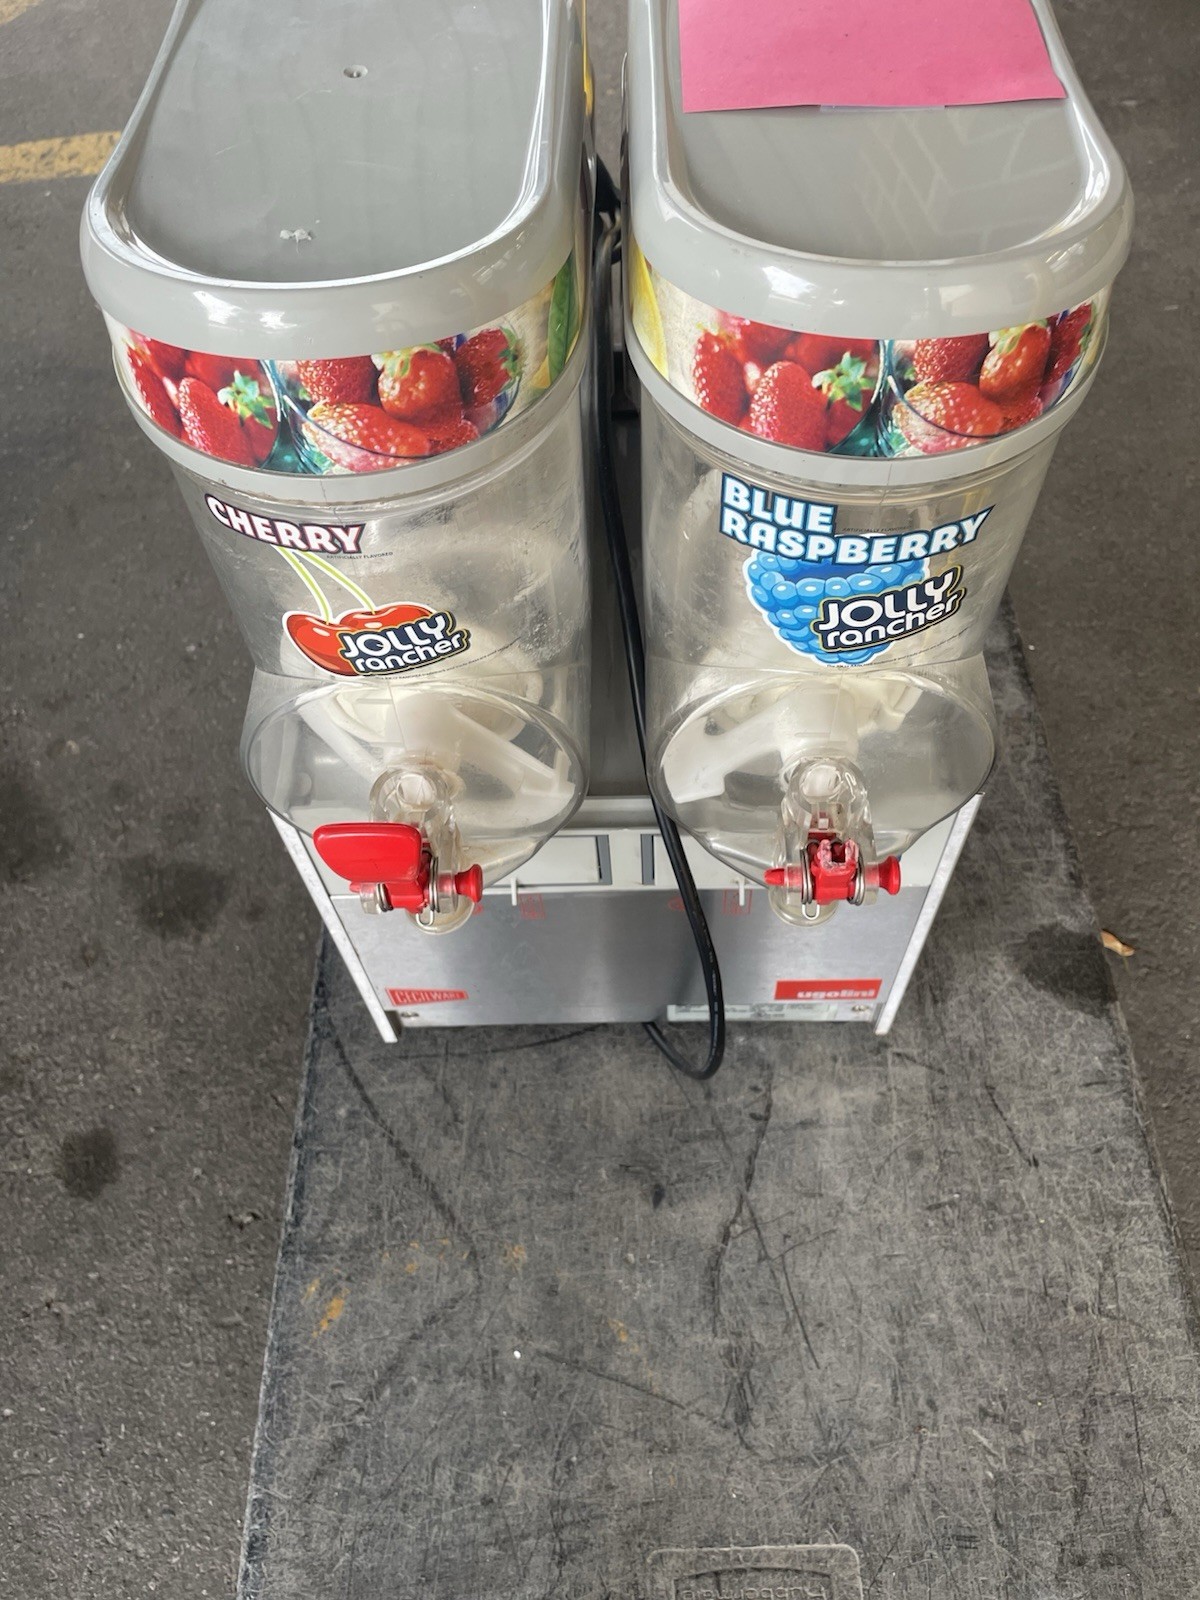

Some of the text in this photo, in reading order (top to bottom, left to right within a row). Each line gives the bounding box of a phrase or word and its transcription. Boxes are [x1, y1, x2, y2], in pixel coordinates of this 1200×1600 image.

[205, 494, 366, 554] CHERRY
[722, 472, 838, 533] BLUE
[719, 504, 996, 565] RASPBERRY
[818, 570, 955, 631] JOLLY
[826, 594, 958, 647] rancher
[341, 613, 447, 658] JOLLY
[355, 632, 464, 672] rancher
